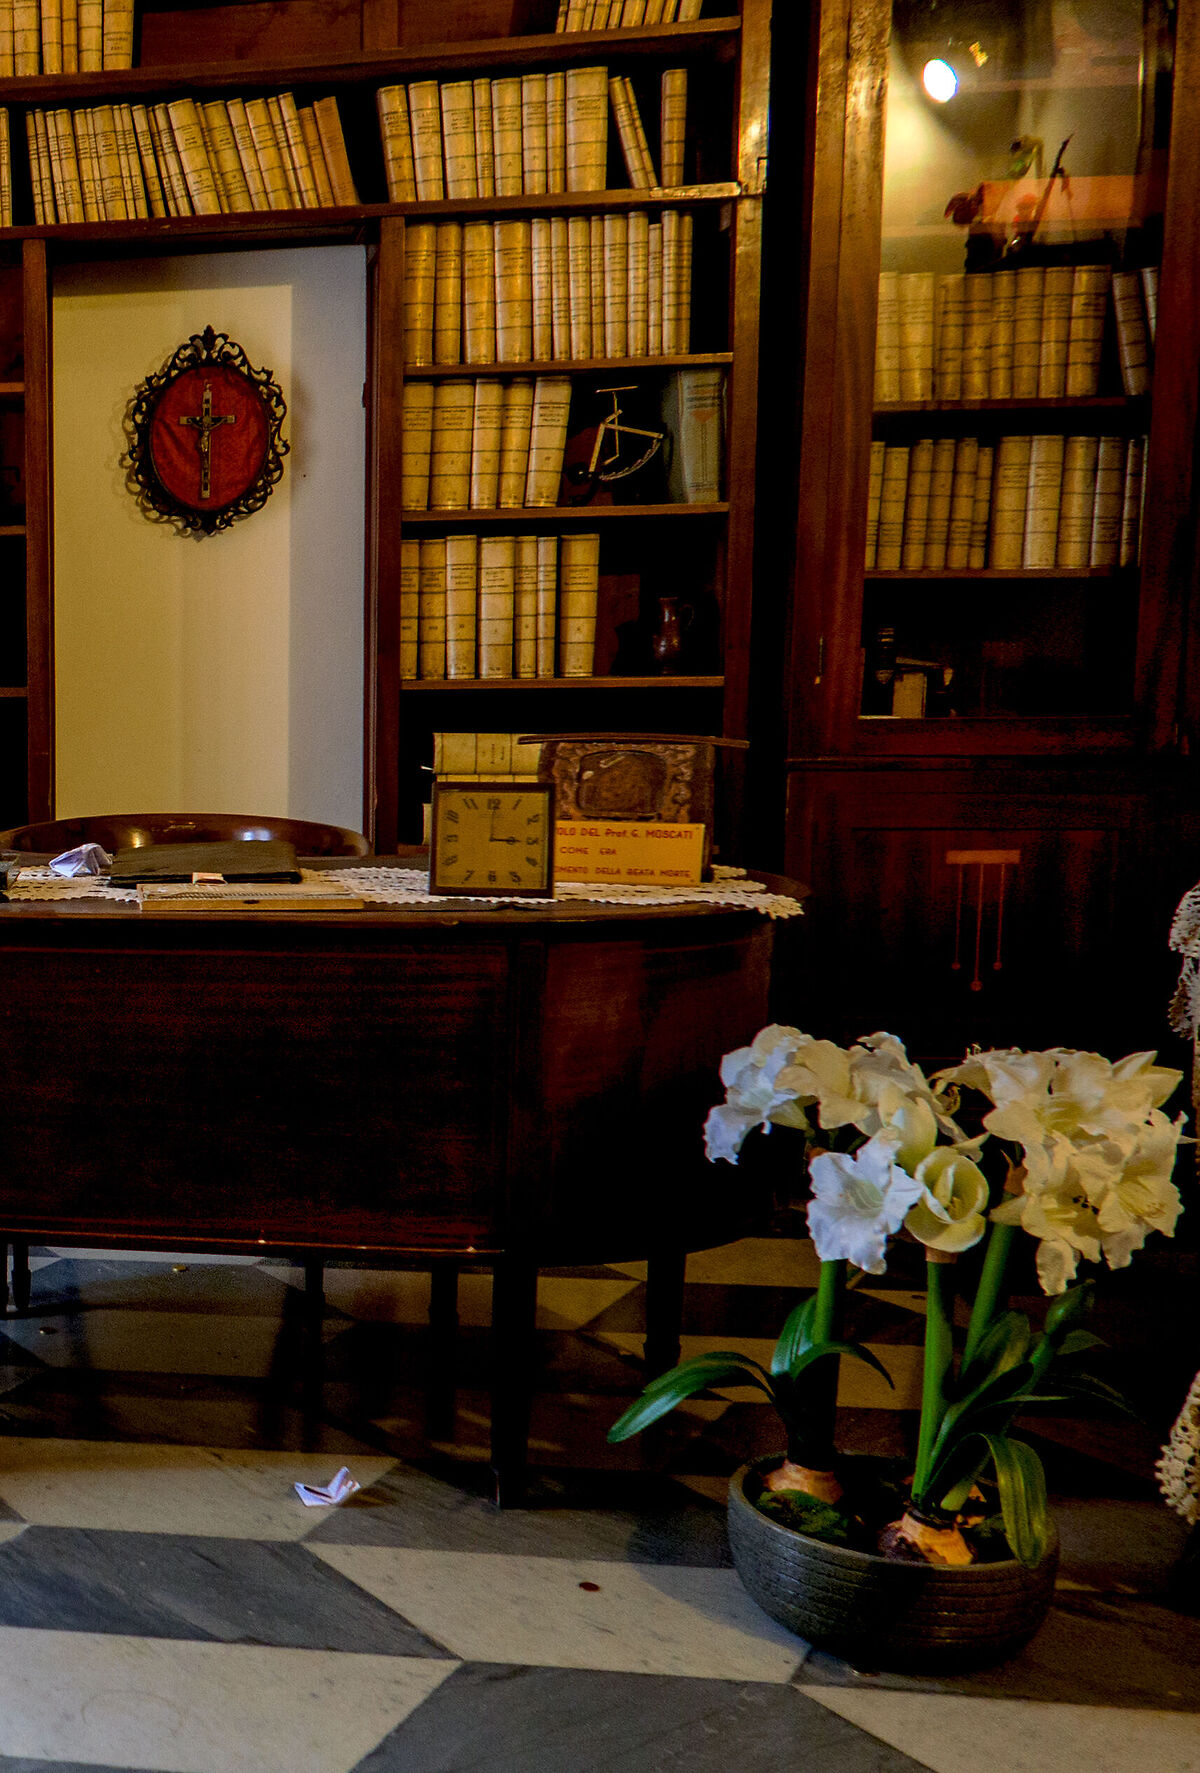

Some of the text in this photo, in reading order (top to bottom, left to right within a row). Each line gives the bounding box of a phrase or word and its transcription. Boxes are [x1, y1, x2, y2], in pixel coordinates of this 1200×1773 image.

[556, 827, 577, 836] OLO
[580, 827, 601, 837] DEL
[646, 829, 693, 840] MOSCATI
[560, 846, 617, 856] COME ERA
[554, 866, 588, 875] OMENTO
[595, 866, 622, 876] DELLA
